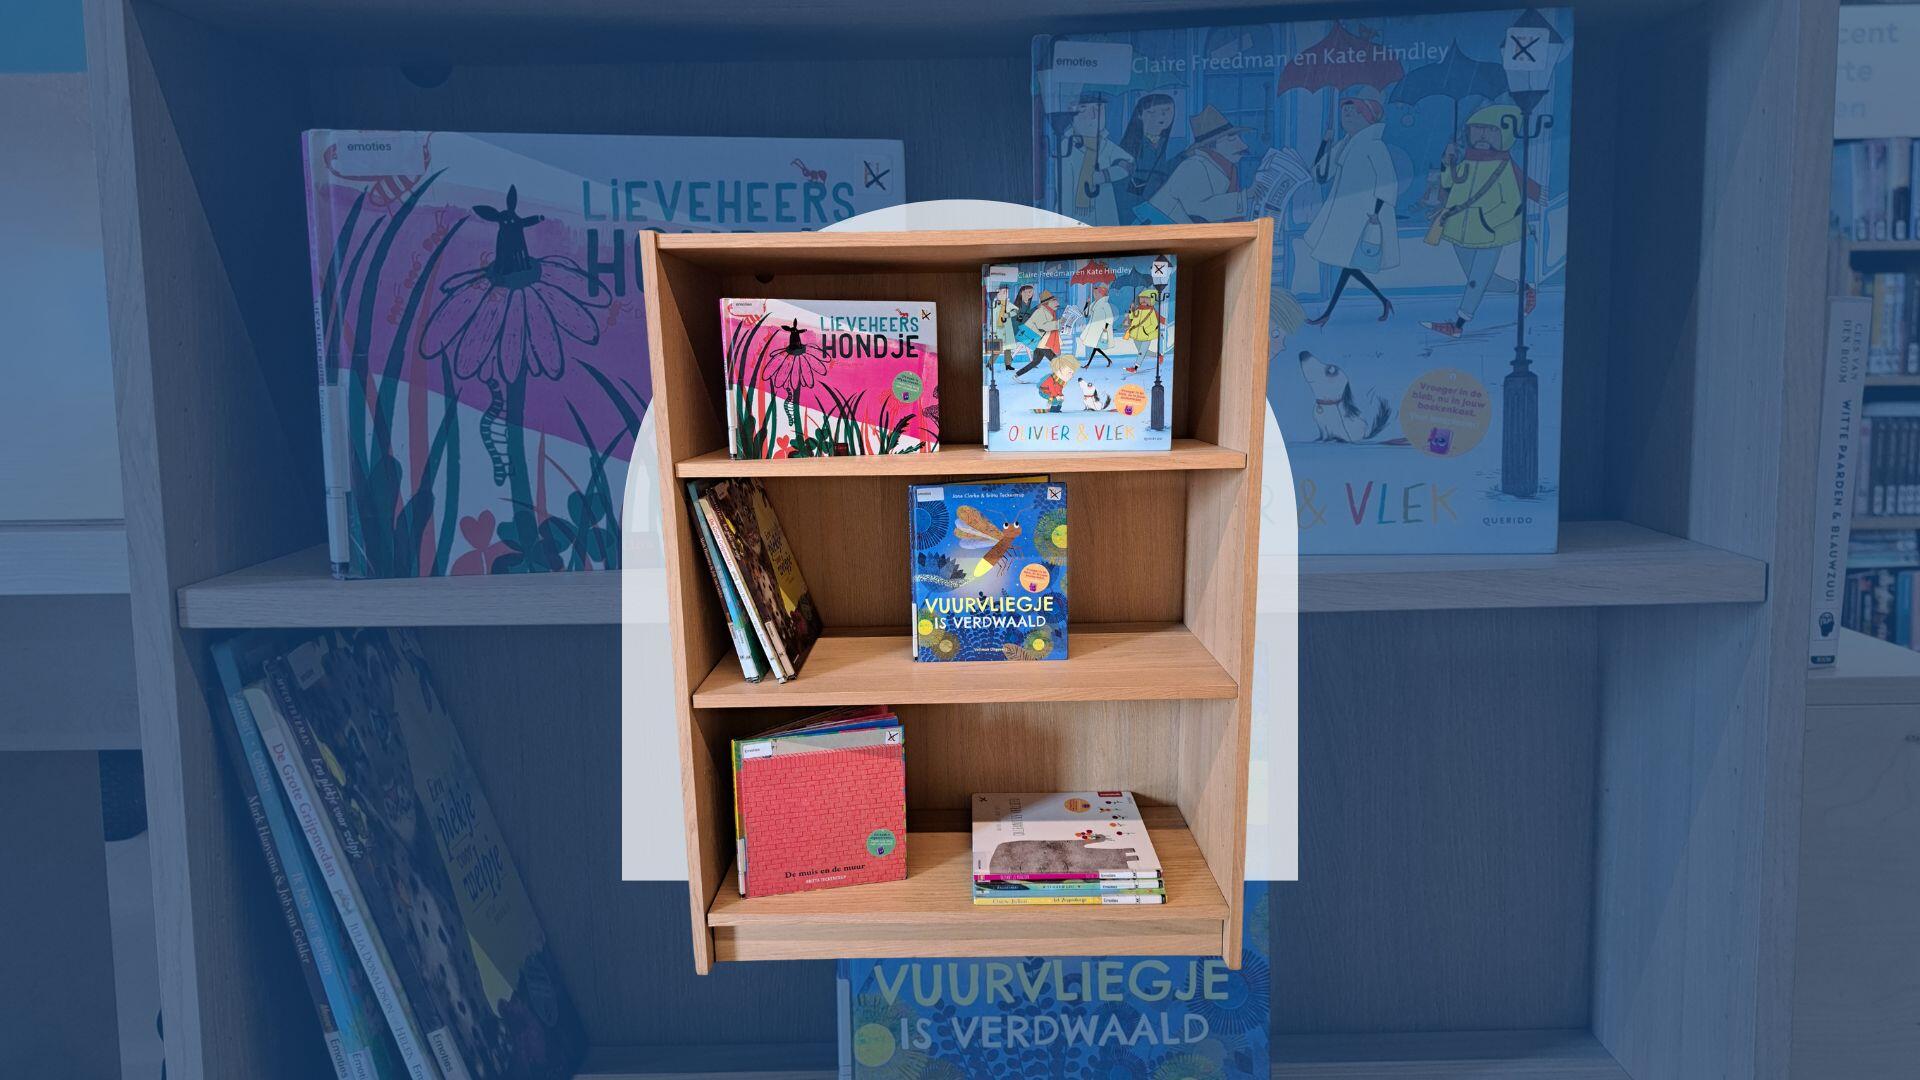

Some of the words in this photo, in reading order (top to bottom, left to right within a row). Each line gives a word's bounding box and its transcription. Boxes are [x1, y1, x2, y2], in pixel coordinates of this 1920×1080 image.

[1055, 56, 1099, 69] emoties
[1132, 55, 1187, 74] Claire
[1191, 51, 1287, 71] Freedman
[1294, 52, 1317, 67] en
[1324, 47, 1367, 65] Kate
[1372, 42, 1450, 64] Hindley
[346, 142, 393, 152] emoties
[1105, 266, 1133, 276] Hindley
[1838, 348, 1850, 384] BOOM
[1418, 381, 1459, 396] Vroeger
[1008, 424, 1070, 442] OLIVIER
[1076, 423, 1089, 442] &
[1094, 424, 1135, 441] VLEK
[1838, 399, 1852, 440] WITTE
[1833, 445, 1848, 507] PAARDEN
[1297, 478, 1328, 529] &
[1344, 480, 1459, 526] VLEK
[1481, 515, 1534, 527] QUERIDO
[1831, 511, 1842, 520] &
[1825, 525, 1841, 602] BLAUWZUU
[925, 596, 1054, 615] VUURVLIEGJE
[934, 617, 947, 630] IS
[953, 615, 1046, 629] VERDWAALD
[272, 742, 286, 763] De
[282, 764, 303, 800] Grote
[299, 802, 336, 878] Grijpmedan
[437, 782, 477, 863] plekje
[248, 794, 262, 824] Mark
[276, 886, 291, 904] Job
[292, 928, 312, 965] Gelder
[785, 870, 797, 879] De
[798, 868, 819, 878] muis
[832, 865, 842, 873] de
[844, 863, 866, 873] muur
[349, 922, 365, 954] JULIA
[361, 950, 395, 1014] DONALDSON
[872, 959, 1231, 1007] VUURVLIEGJE
[900, 1017, 932, 1050] IS
[951, 1011, 1210, 1050] VERDWAALD
[432, 1033, 454, 1073] Emoties
